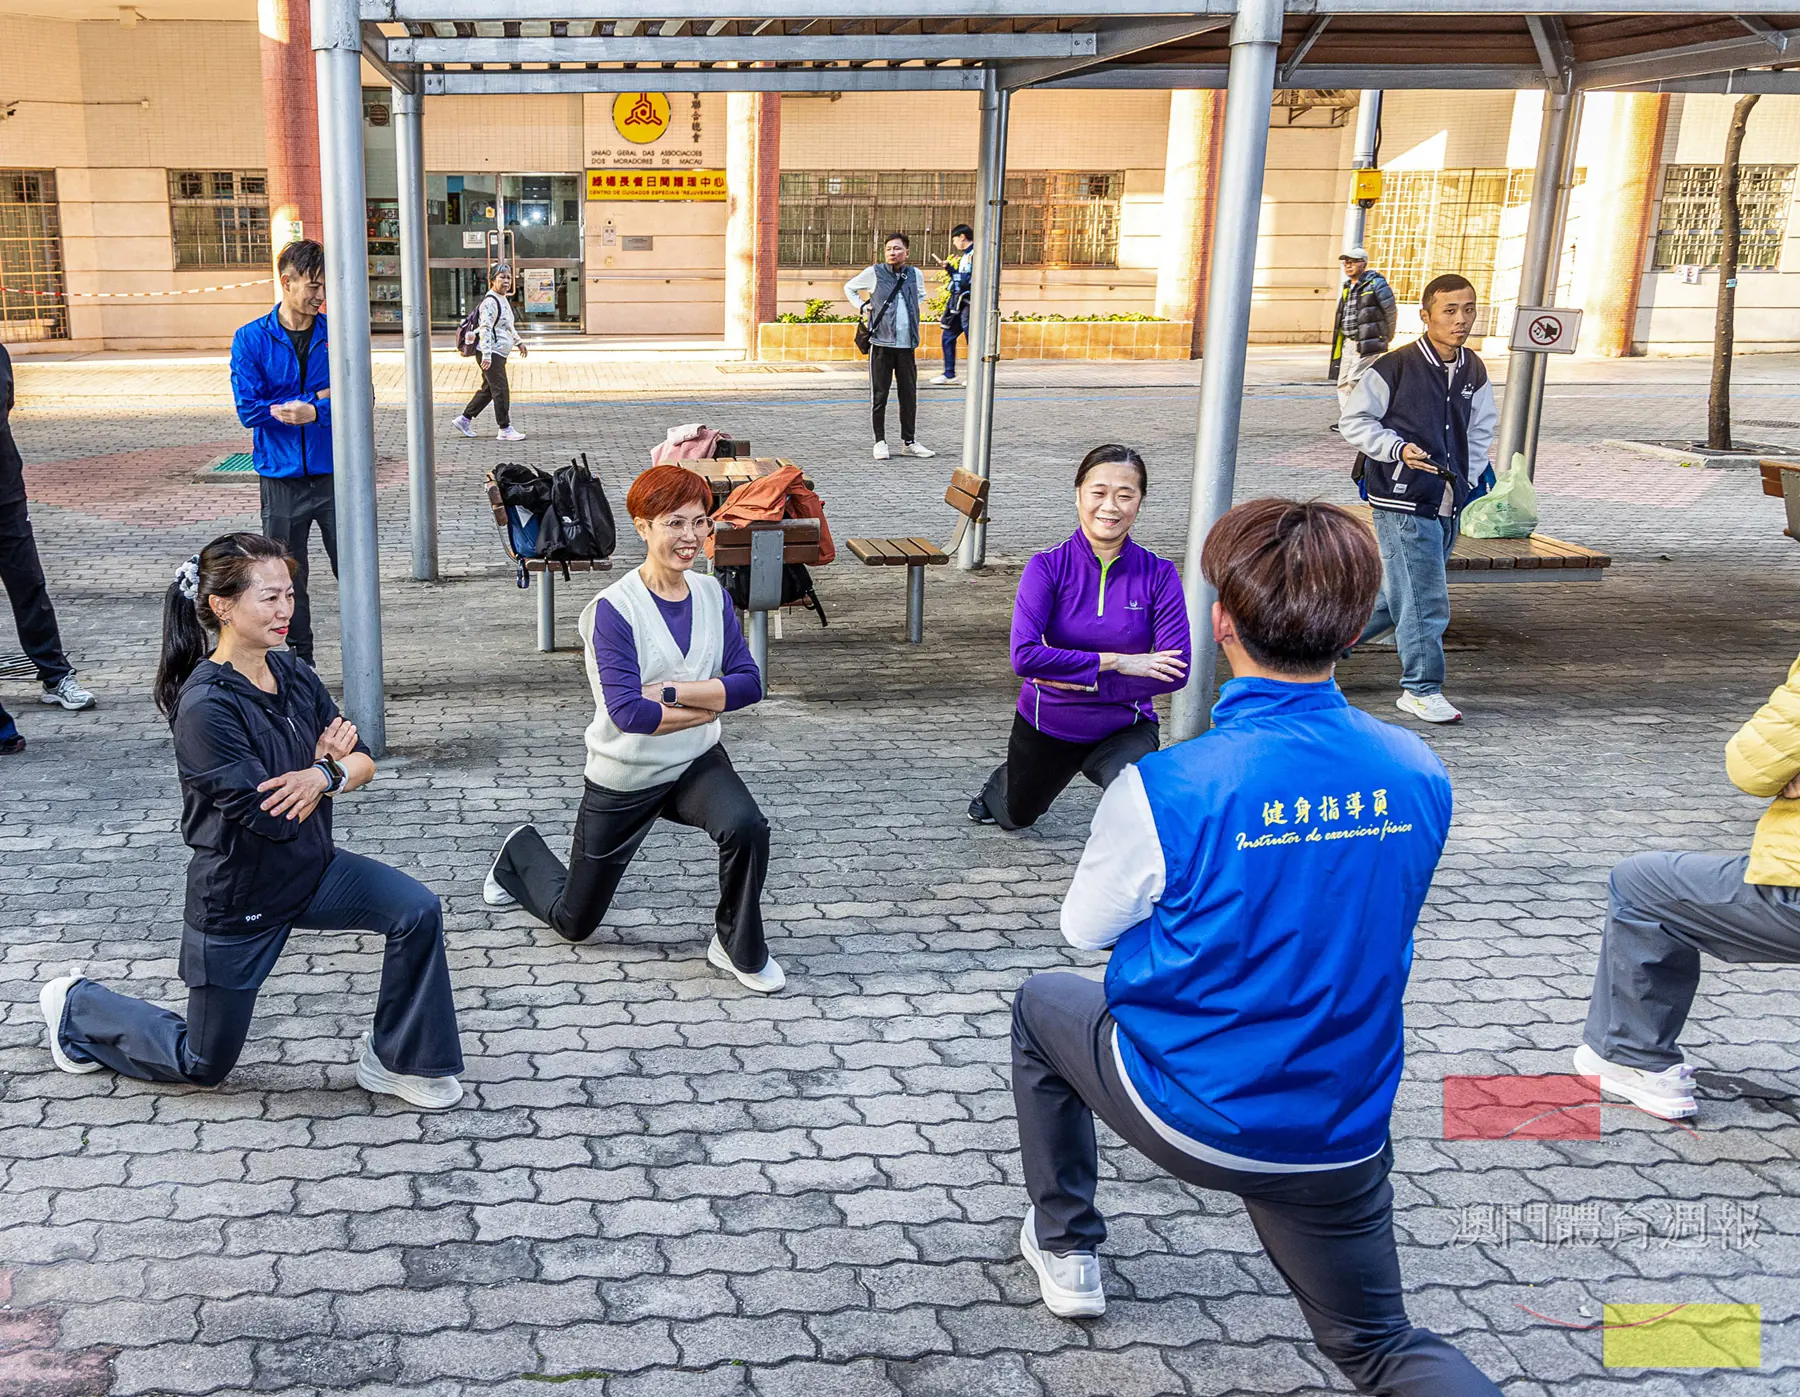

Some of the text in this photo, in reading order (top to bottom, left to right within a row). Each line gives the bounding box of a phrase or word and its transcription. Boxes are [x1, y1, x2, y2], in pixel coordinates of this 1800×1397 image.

[616, 149, 637, 157] GERAL
[642, 149, 655, 157] DAS
[1261, 788, 1389, 827] 健身指導員
[1235, 832, 1302, 851] Instrutor
[1305, 827, 1323, 843] de
